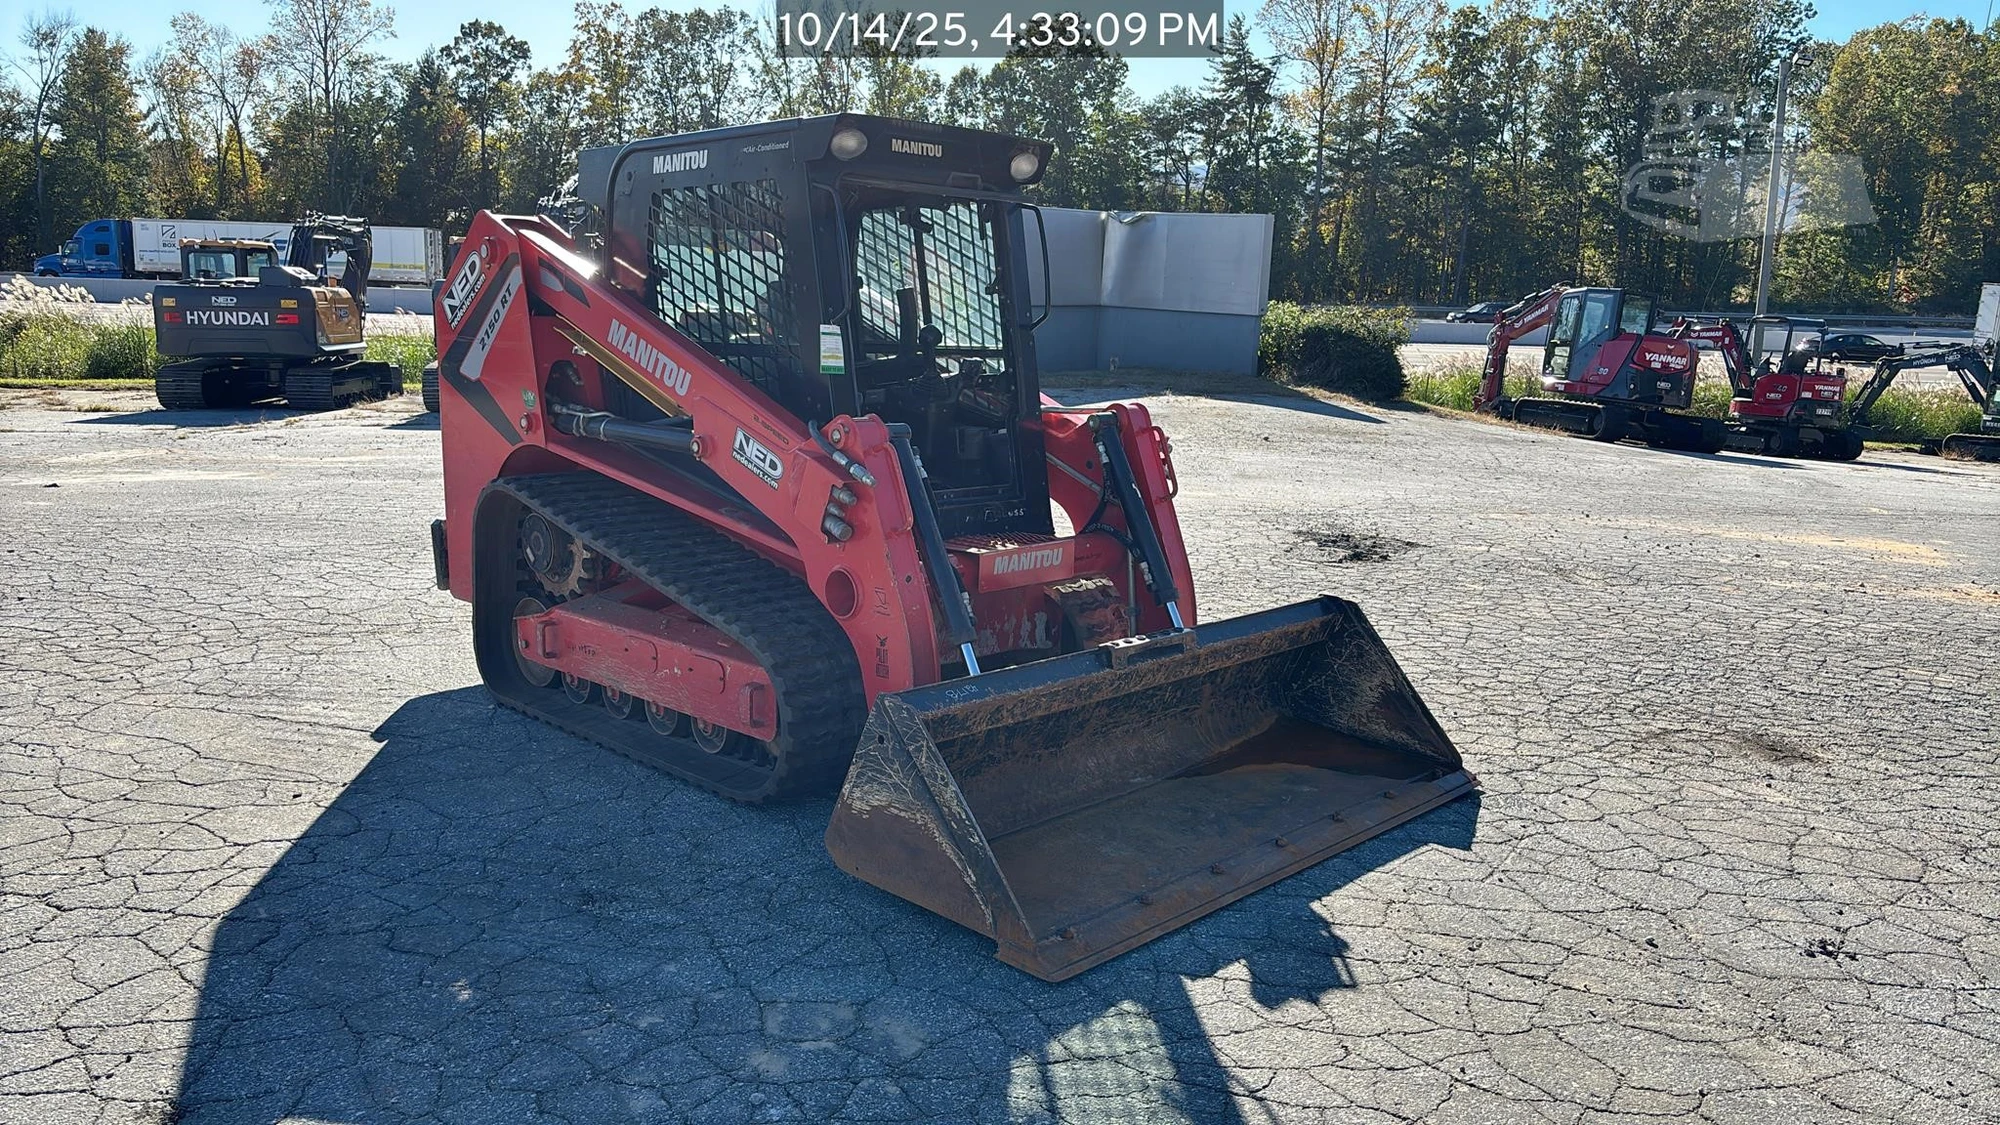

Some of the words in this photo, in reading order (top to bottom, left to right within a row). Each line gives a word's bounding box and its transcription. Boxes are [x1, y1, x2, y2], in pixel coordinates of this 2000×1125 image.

[653, 150, 708, 174] MANITOU
[892, 138, 943, 158] MANITOU
[211, 296, 237, 304] NED
[442, 251, 481, 323] NED
[451, 273, 486, 330] nedealers.com
[1524, 304, 1549, 323] YANMAR
[186, 311, 269, 326] HYUNDAI
[479, 309, 501, 351] 2150
[500, 283, 513, 309] RT
[607, 318, 692, 396] MANITOU
[1645, 352, 1688, 366] YANMAR
[733, 427, 784, 479] NED
[732, 451, 779, 489] nedealers.com
[994, 547, 1063, 575] MANITOU
